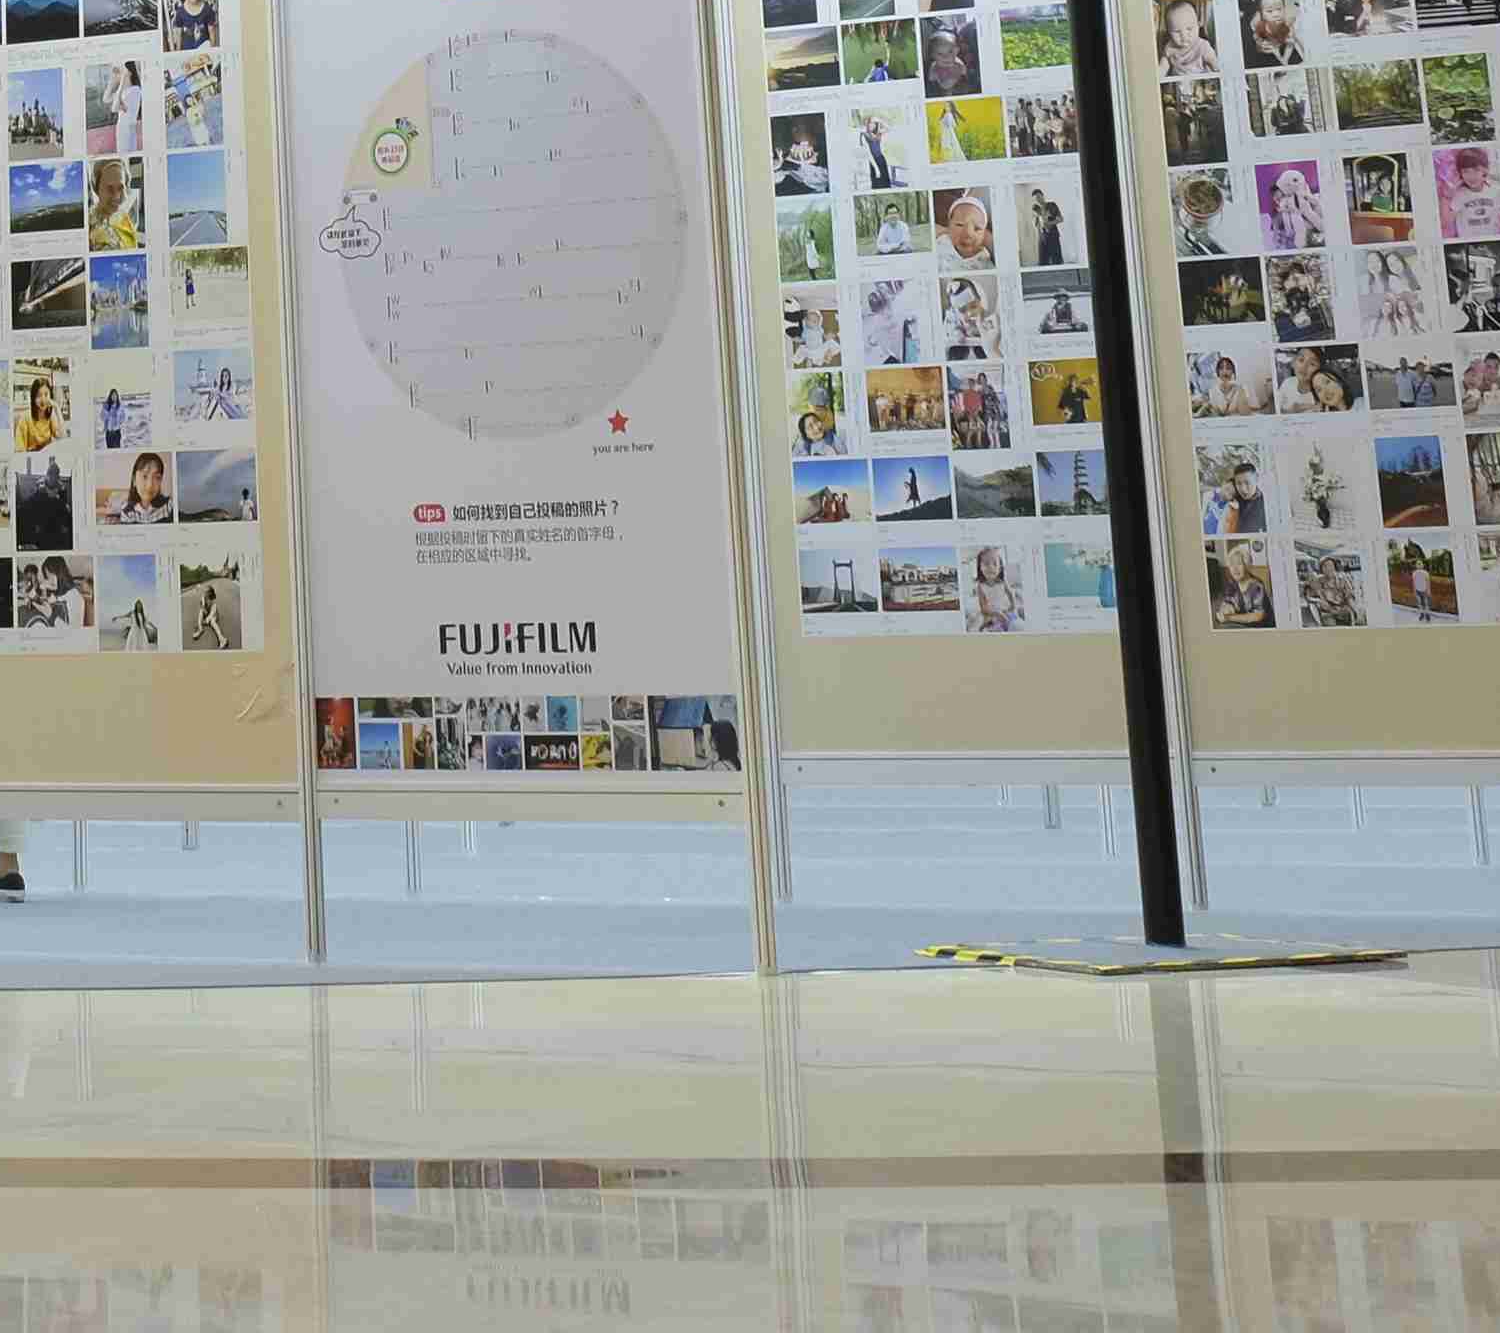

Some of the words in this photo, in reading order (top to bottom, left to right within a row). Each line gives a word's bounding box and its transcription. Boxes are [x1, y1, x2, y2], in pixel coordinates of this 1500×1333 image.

[417, 505, 441, 521] tips
[438, 621, 597, 655] FUJIFILM
[447, 662, 482, 675] Value
[486, 661, 518, 675] from
[522, 660, 593, 675] Innovation
